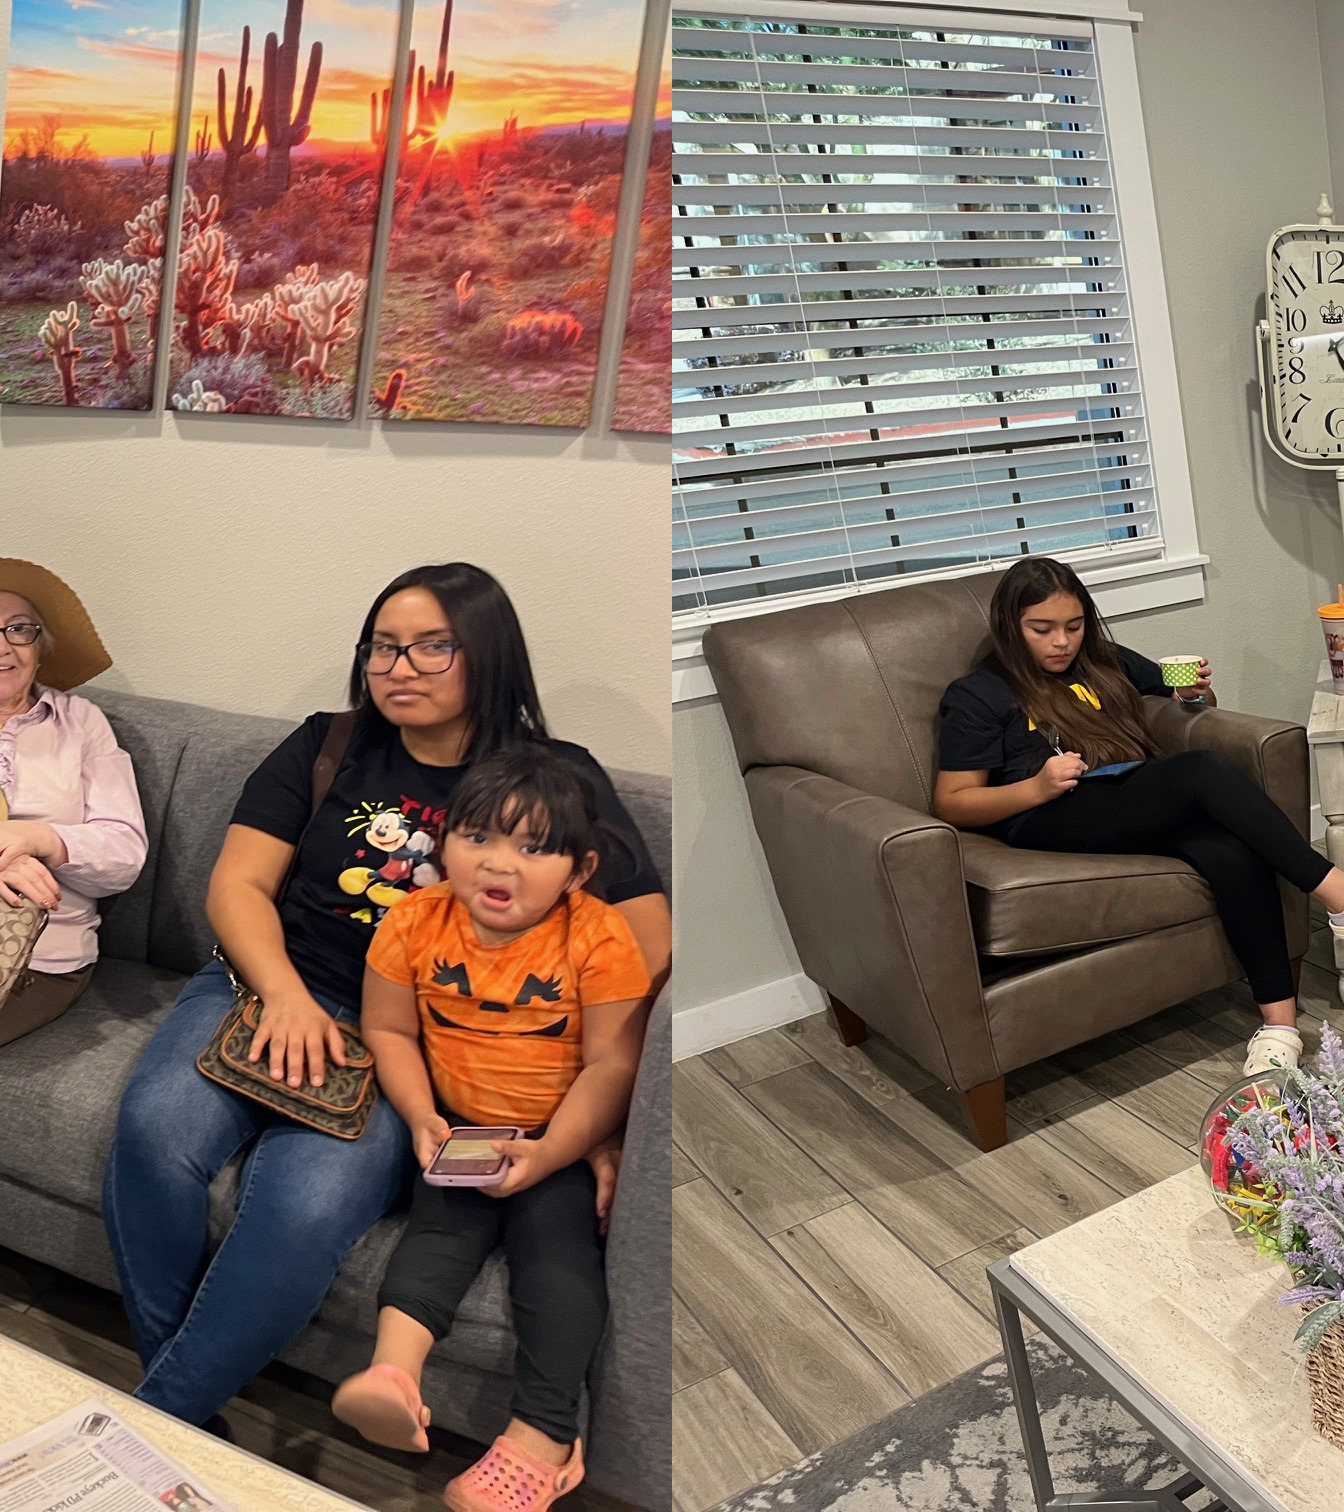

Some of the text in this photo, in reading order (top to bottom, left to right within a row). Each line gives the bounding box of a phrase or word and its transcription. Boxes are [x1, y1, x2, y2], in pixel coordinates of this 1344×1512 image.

[1280, 262, 1307, 299] 11
[1285, 308, 1307, 332] 10
[1287, 337, 1305, 354] 9
[1288, 357, 1306, 384] 8
[1292, 393, 1312, 423] 7
